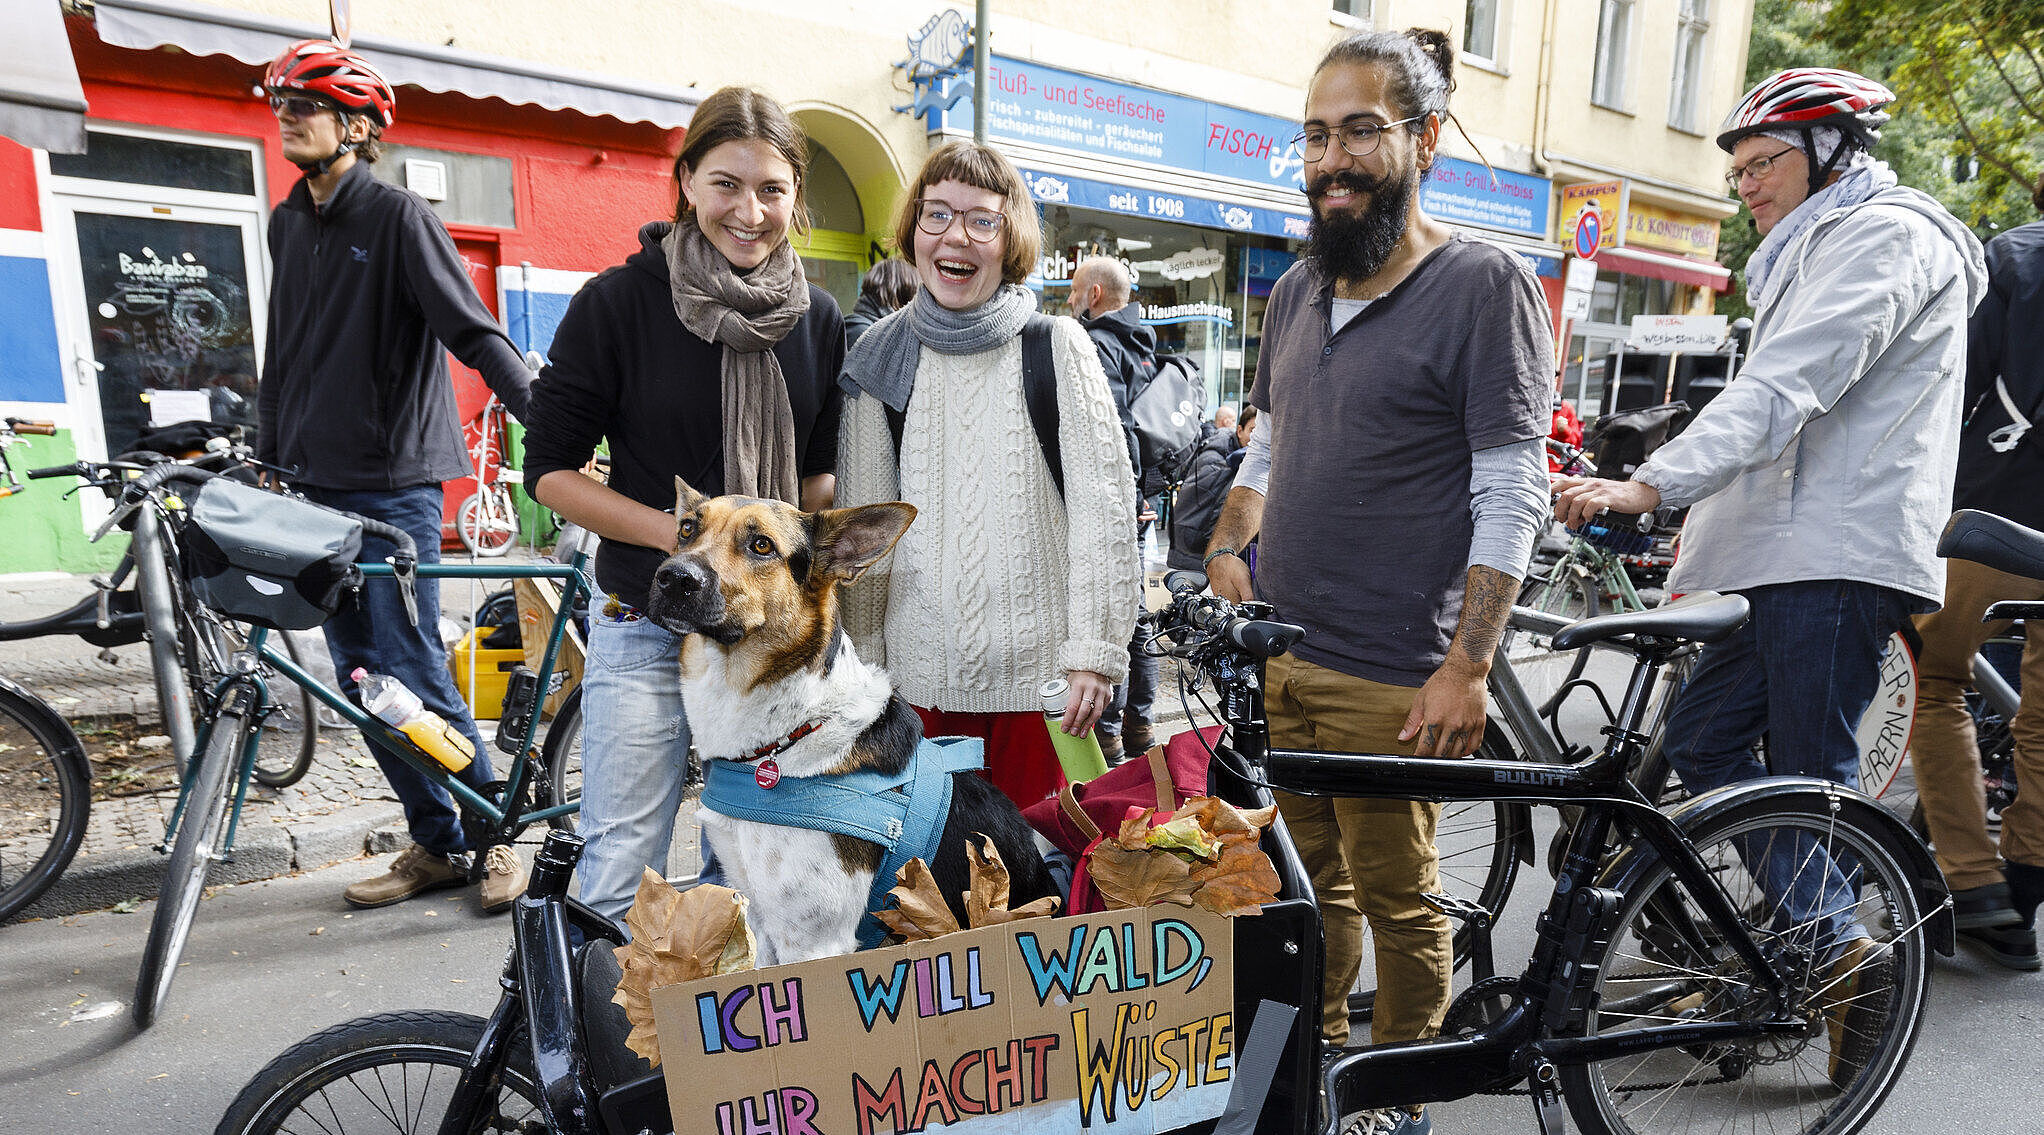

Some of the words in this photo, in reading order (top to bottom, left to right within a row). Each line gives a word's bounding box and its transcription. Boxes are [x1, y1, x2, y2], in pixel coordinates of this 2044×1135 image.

[1044, 84, 1078, 105] und
[1083, 88, 1166, 124] Seefische
[990, 98, 1022, 117] risch
[1035, 109, 1093, 130] zubereitet
[1105, 123, 1163, 144] geräuchert
[1086, 134, 1105, 148] und
[1107, 136, 1163, 158] Fischsalate
[1464, 170, 1488, 191] Grill
[1500, 178, 1534, 200] Imbiss
[1568, 183, 1617, 199] KAMPUS
[1109, 193, 1139, 212] seit
[1148, 196, 1185, 218] 1908
[1636, 214, 1644, 232] &
[1648, 217, 1716, 244] KONDITOREI
[1148, 301, 1232, 321] Hausmacherart
[1859, 711, 1908, 794] HRERN
[1494, 770, 1567, 786] BULLITT
[695, 977, 808, 1055] ICH
[846, 947, 994, 1032] WILL
[1015, 918, 1214, 1007] WALD,
[715, 1086, 825, 1135] IHR
[852, 1034, 1060, 1135] MACHT
[1071, 1000, 1233, 1128] WÜSTE
